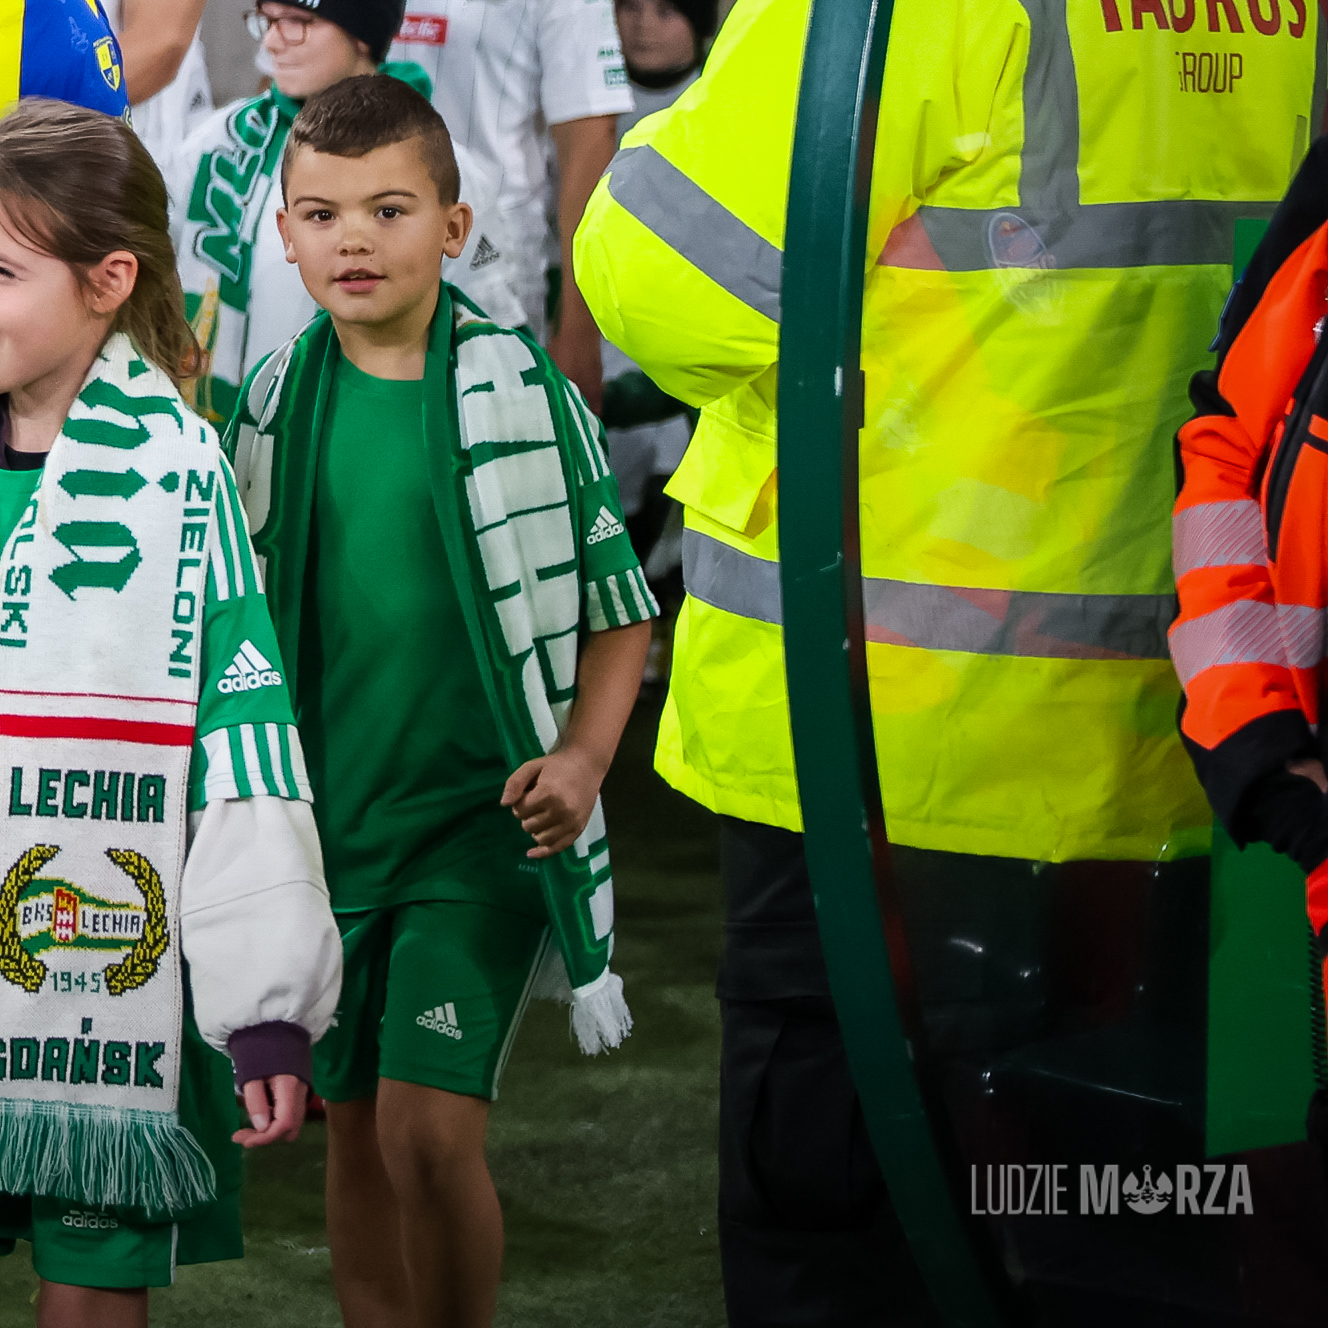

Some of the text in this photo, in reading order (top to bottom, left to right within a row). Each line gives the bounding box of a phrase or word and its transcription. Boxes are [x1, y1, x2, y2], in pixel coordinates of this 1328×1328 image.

[586, 522, 625, 545] adidas
[217, 670, 283, 694] adidas
[8, 766, 167, 823] LECHIA
[82, 909, 142, 934] LECHIA
[50, 971, 101, 993] 1945
[416, 1015, 463, 1040] adidas
[62, 1214, 119, 1229] adidas
